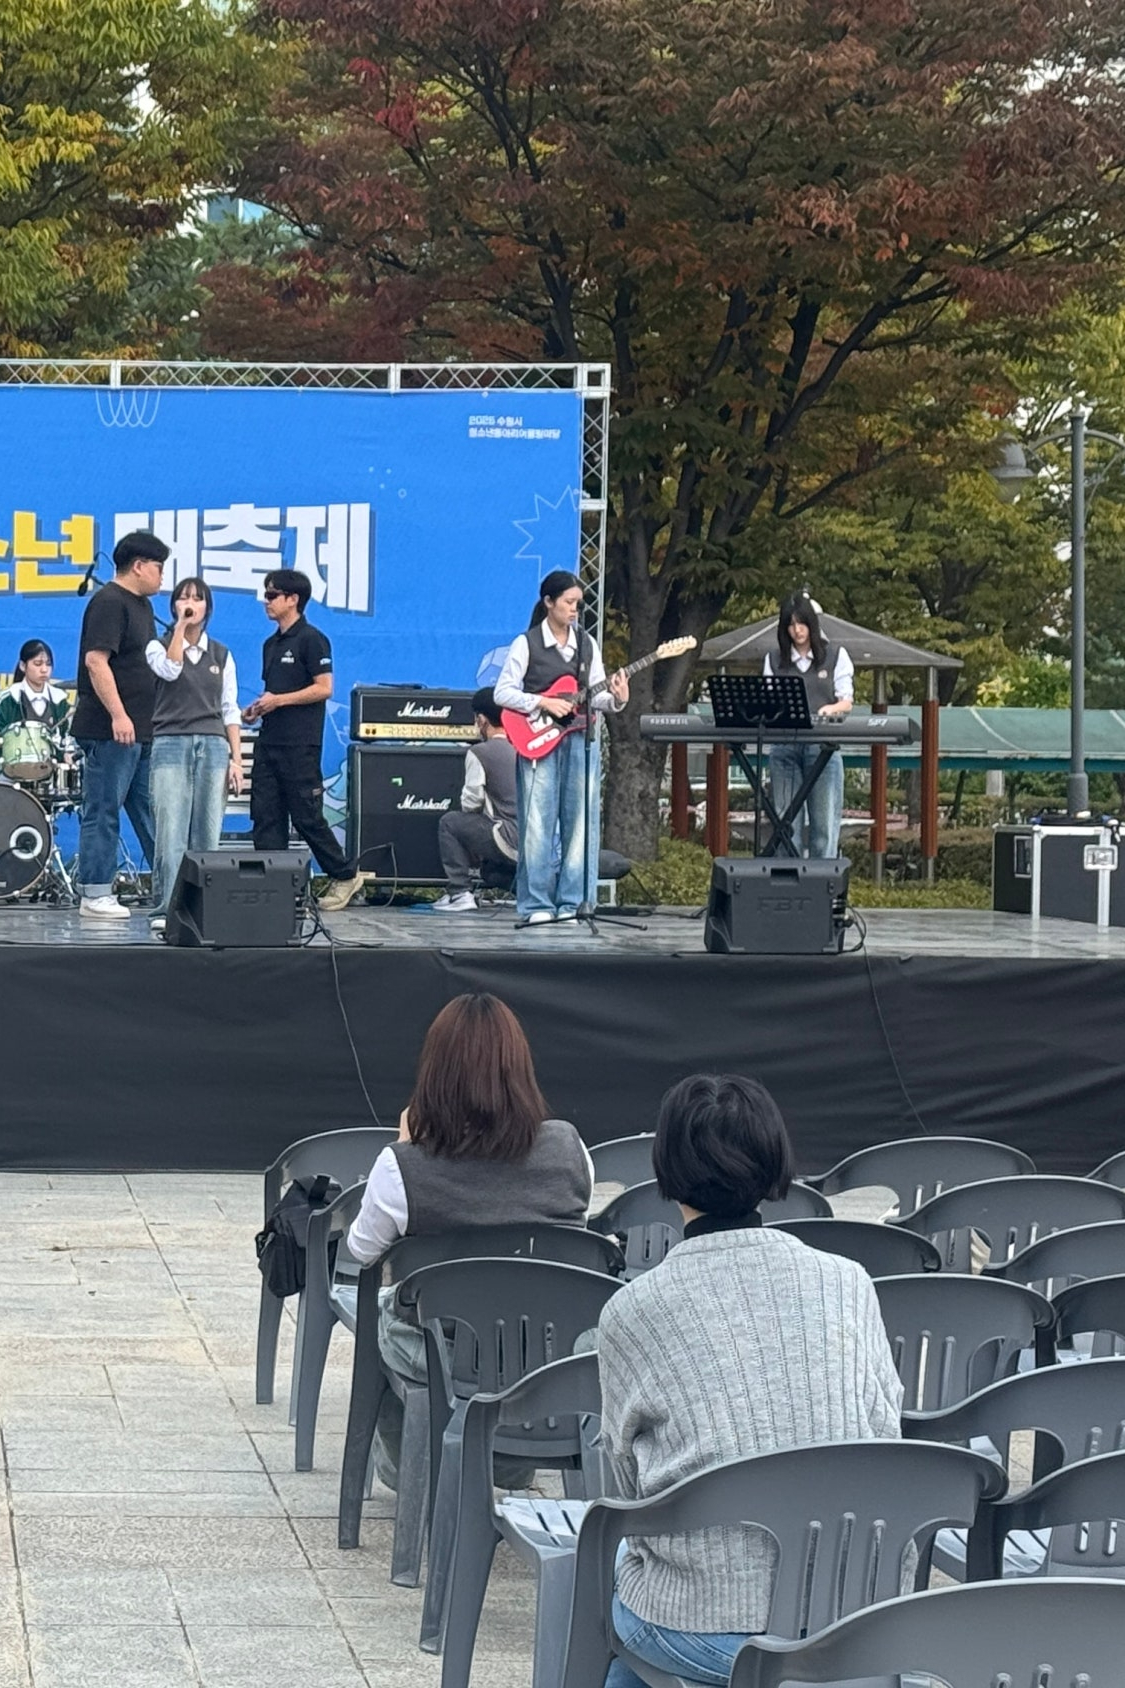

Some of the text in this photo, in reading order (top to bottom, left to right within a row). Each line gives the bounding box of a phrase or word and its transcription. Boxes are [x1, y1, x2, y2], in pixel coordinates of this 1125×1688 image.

[397, 701, 451, 719] Marshall
[397, 794, 451, 811] Marshall
[226, 889, 279, 905] FBT
[756, 896, 813, 912] FBT
